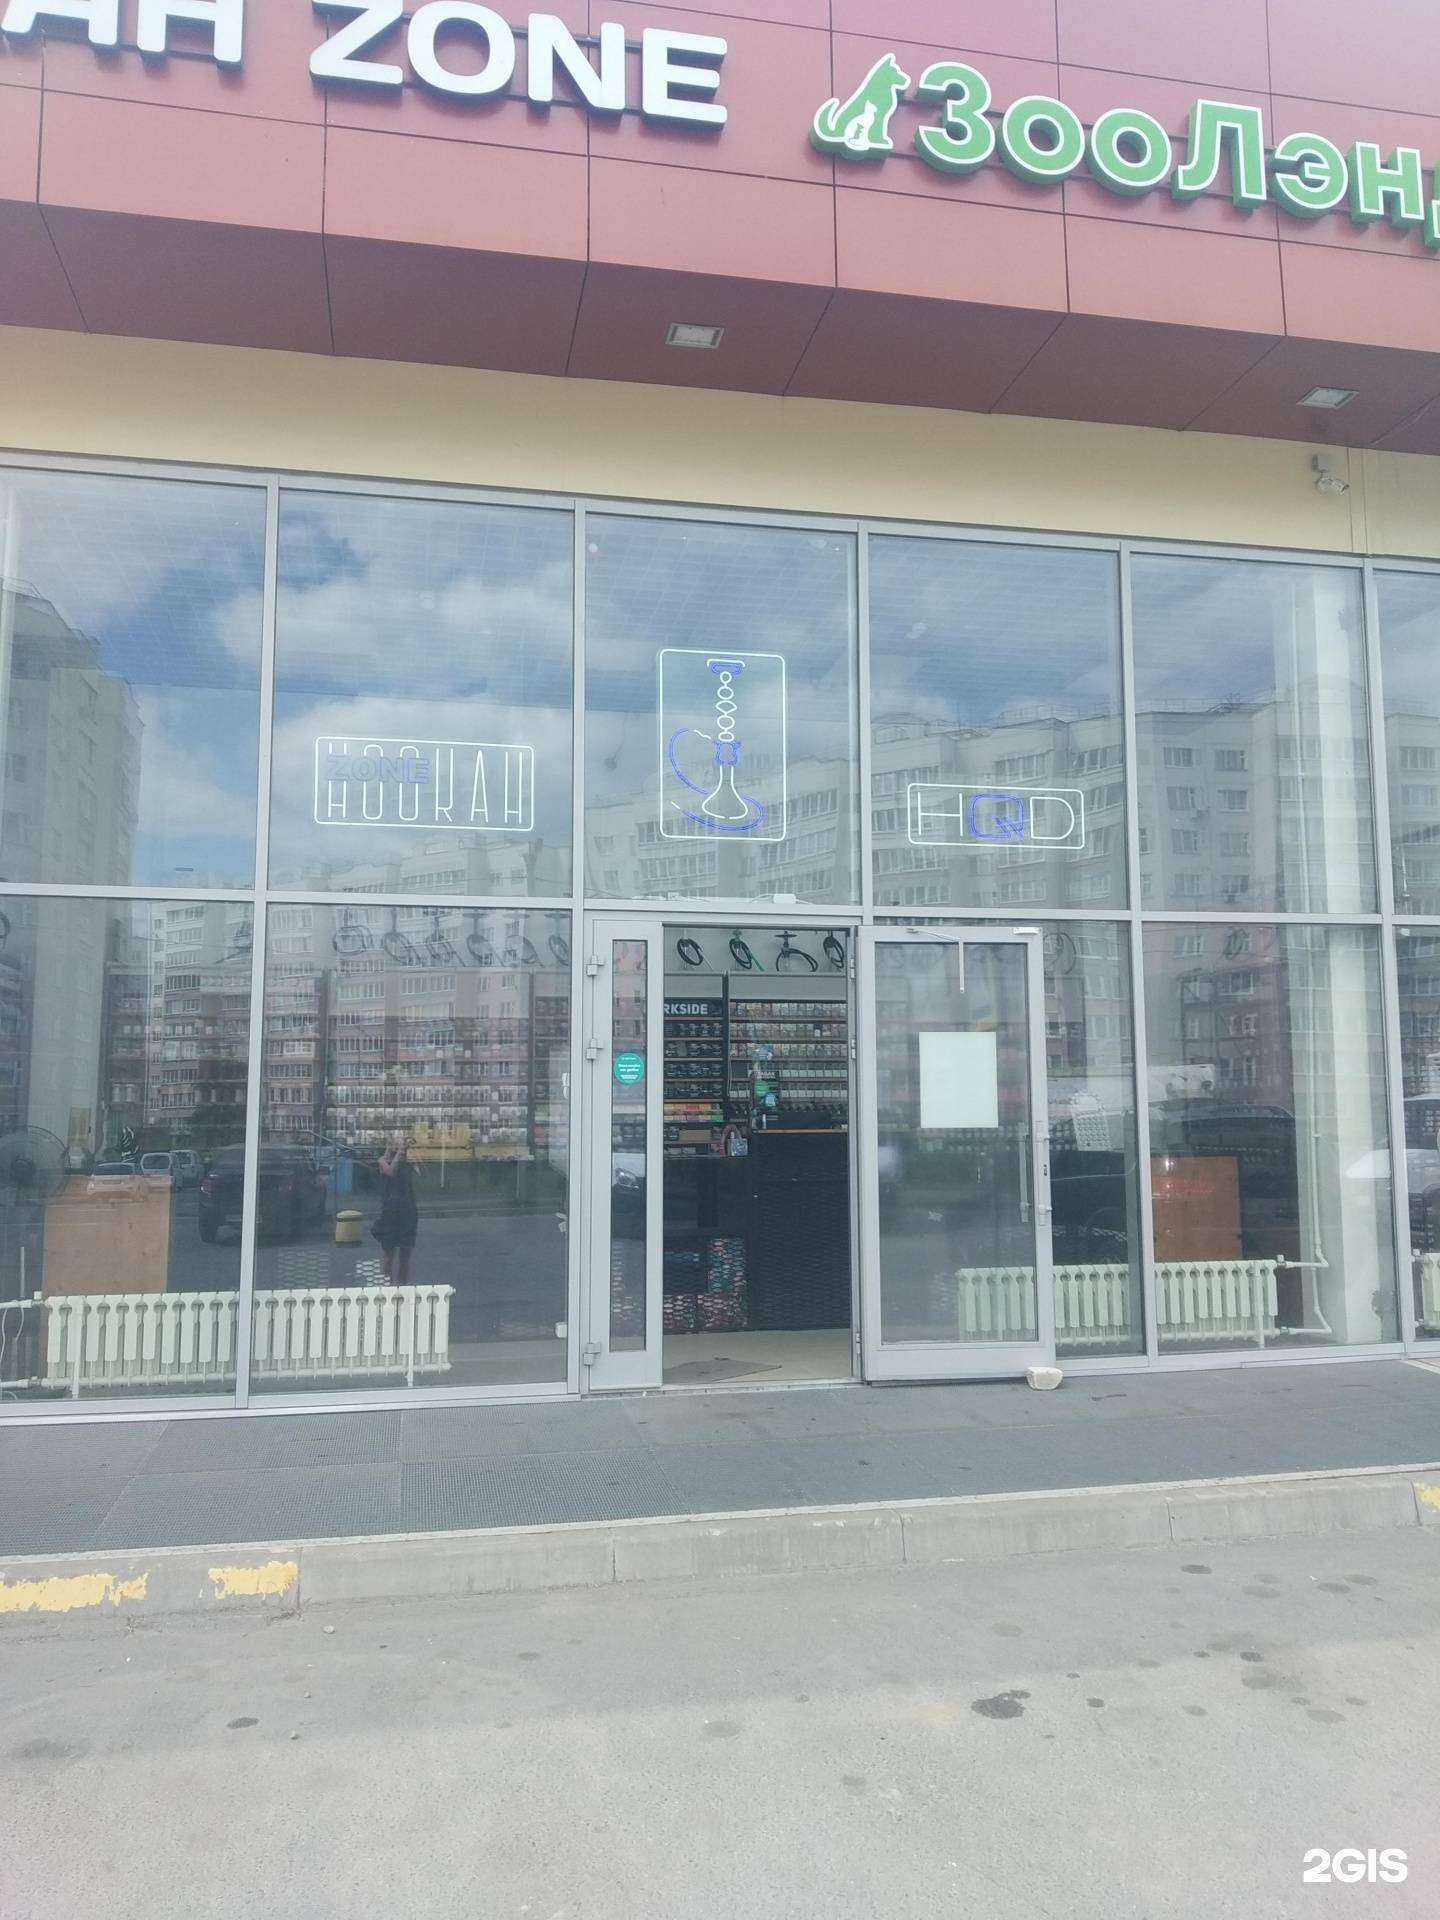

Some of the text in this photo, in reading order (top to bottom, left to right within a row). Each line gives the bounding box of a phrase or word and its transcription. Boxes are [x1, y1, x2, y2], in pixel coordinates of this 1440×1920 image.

[309, 0, 728, 124] ZONE
[915, 61, 1440, 240] ЗооЛэн
[326, 755, 431, 785] ZONE
[917, 791, 1076, 842] HQD
